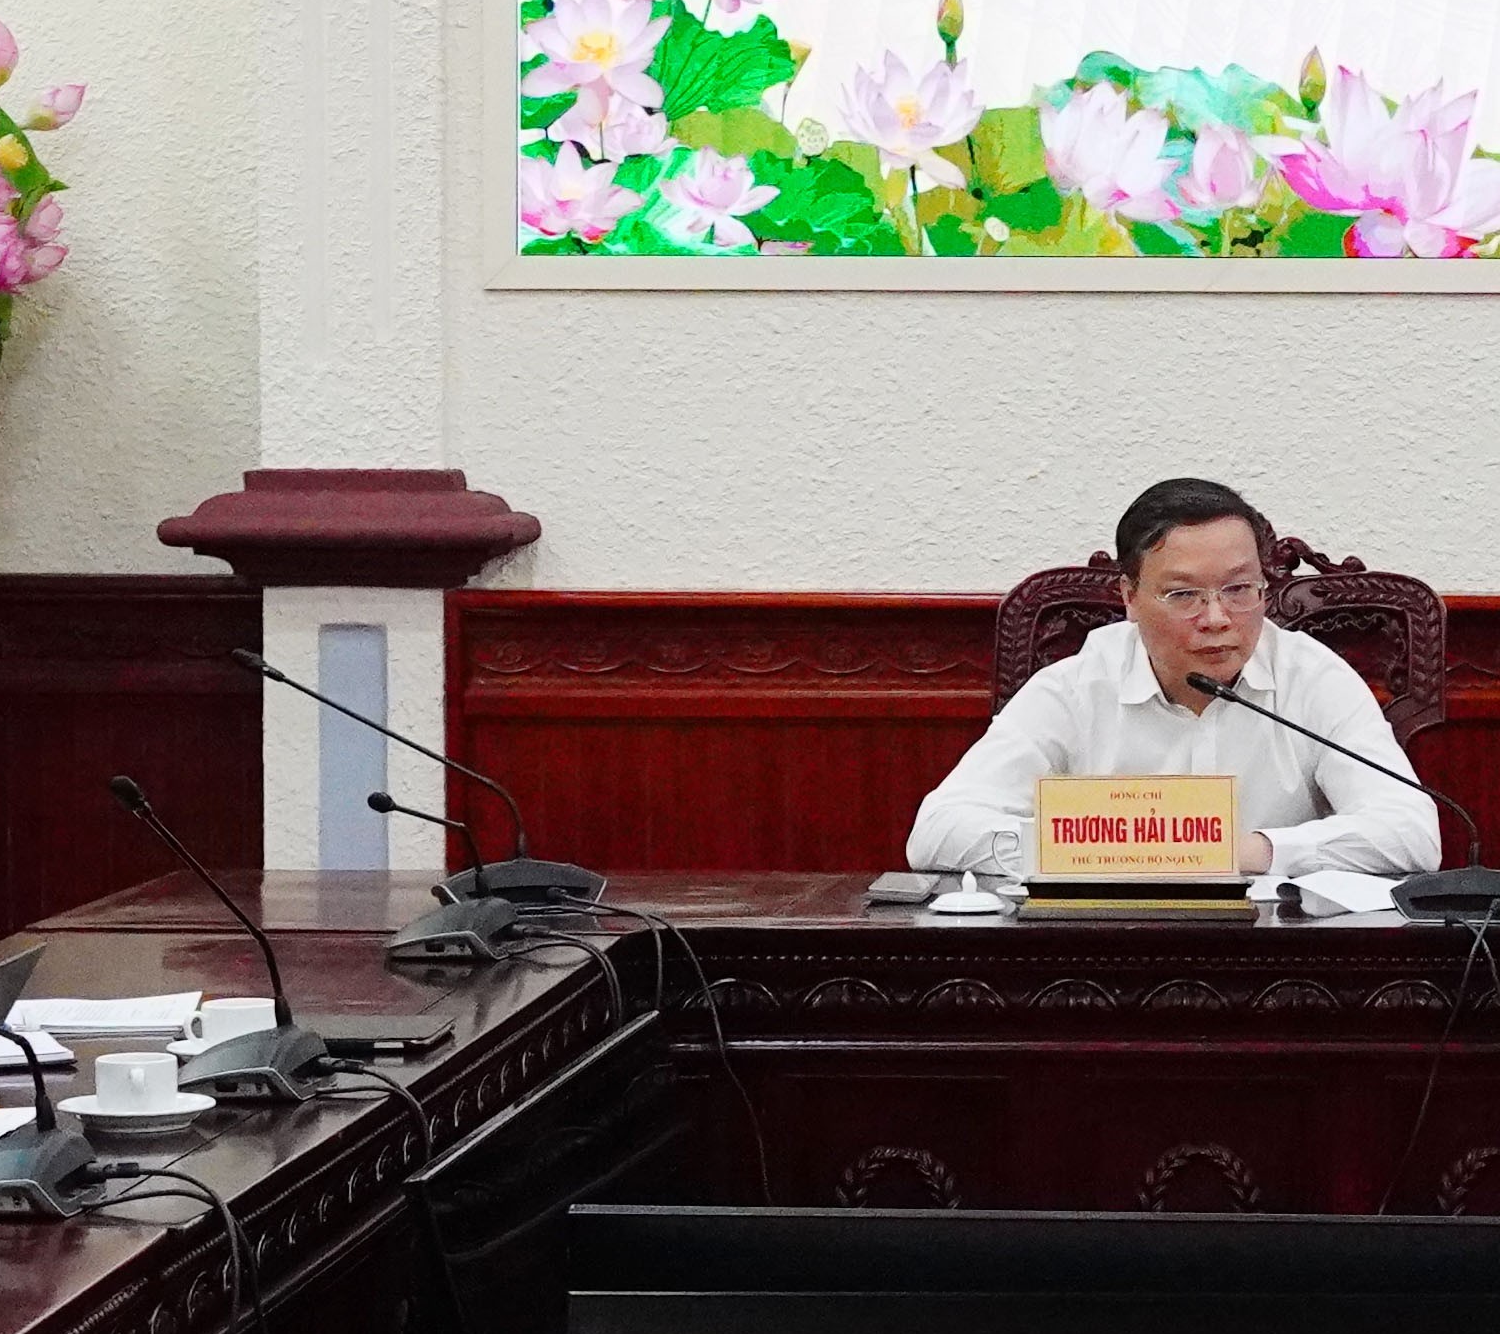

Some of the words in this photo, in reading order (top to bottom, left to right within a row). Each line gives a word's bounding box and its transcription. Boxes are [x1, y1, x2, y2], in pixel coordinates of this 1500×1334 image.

[1051, 815, 1128, 843] TRƯƠNG
[1134, 807, 1166, 843] HẢI
[1172, 816, 1223, 843] LONG
